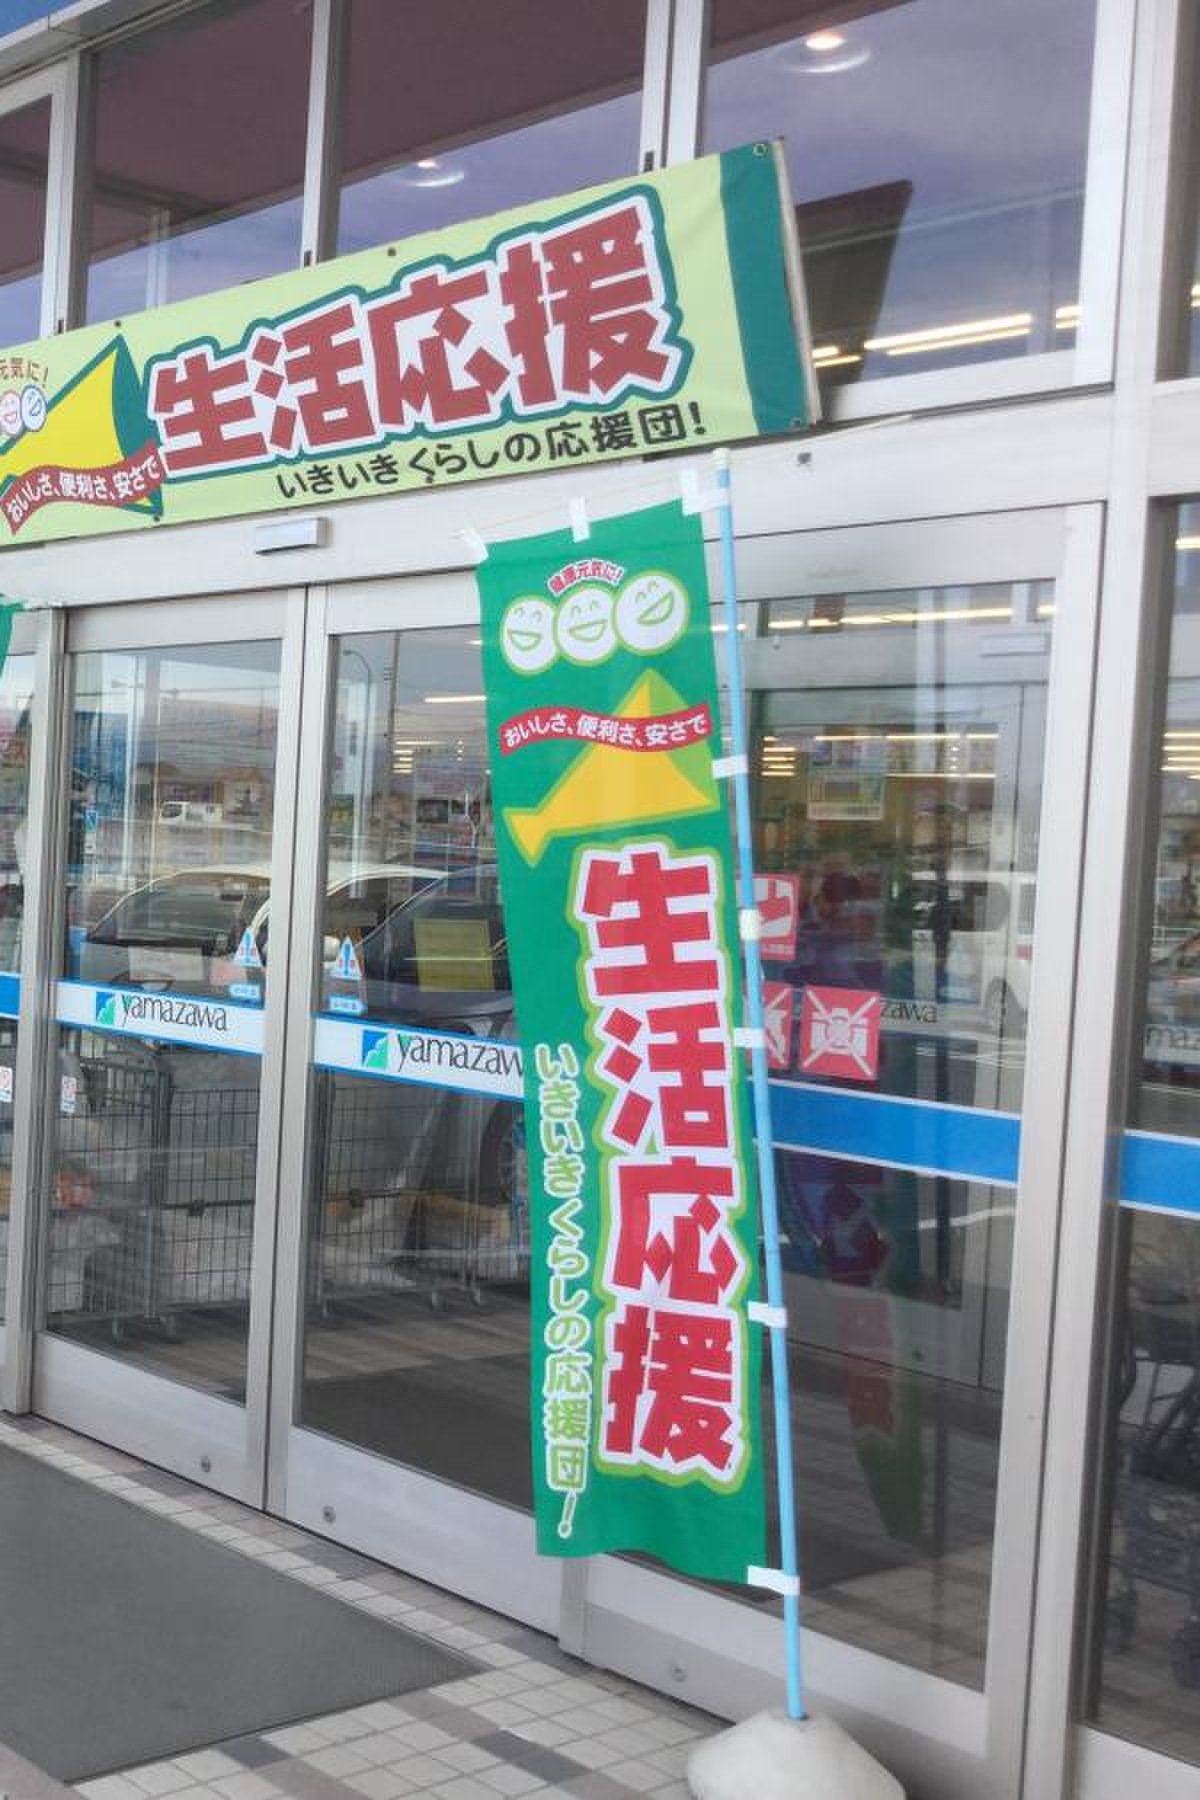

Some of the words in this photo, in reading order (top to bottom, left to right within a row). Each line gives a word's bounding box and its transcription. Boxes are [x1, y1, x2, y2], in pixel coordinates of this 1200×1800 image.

[152, 204, 674, 477] 生活応援
[275, 402, 708, 502] いきいきくらしの応援団!
[5, 455, 161, 522] おいしさ、便利さ、安さで
[505, 713, 708, 749] おいしさ、便利さ、安さで
[120, 991, 228, 1032] yamazawa
[880, 1001, 938, 1023] zawa
[397, 1034, 524, 1078] yamazaw
[581, 850, 739, 1471] 生活応援
